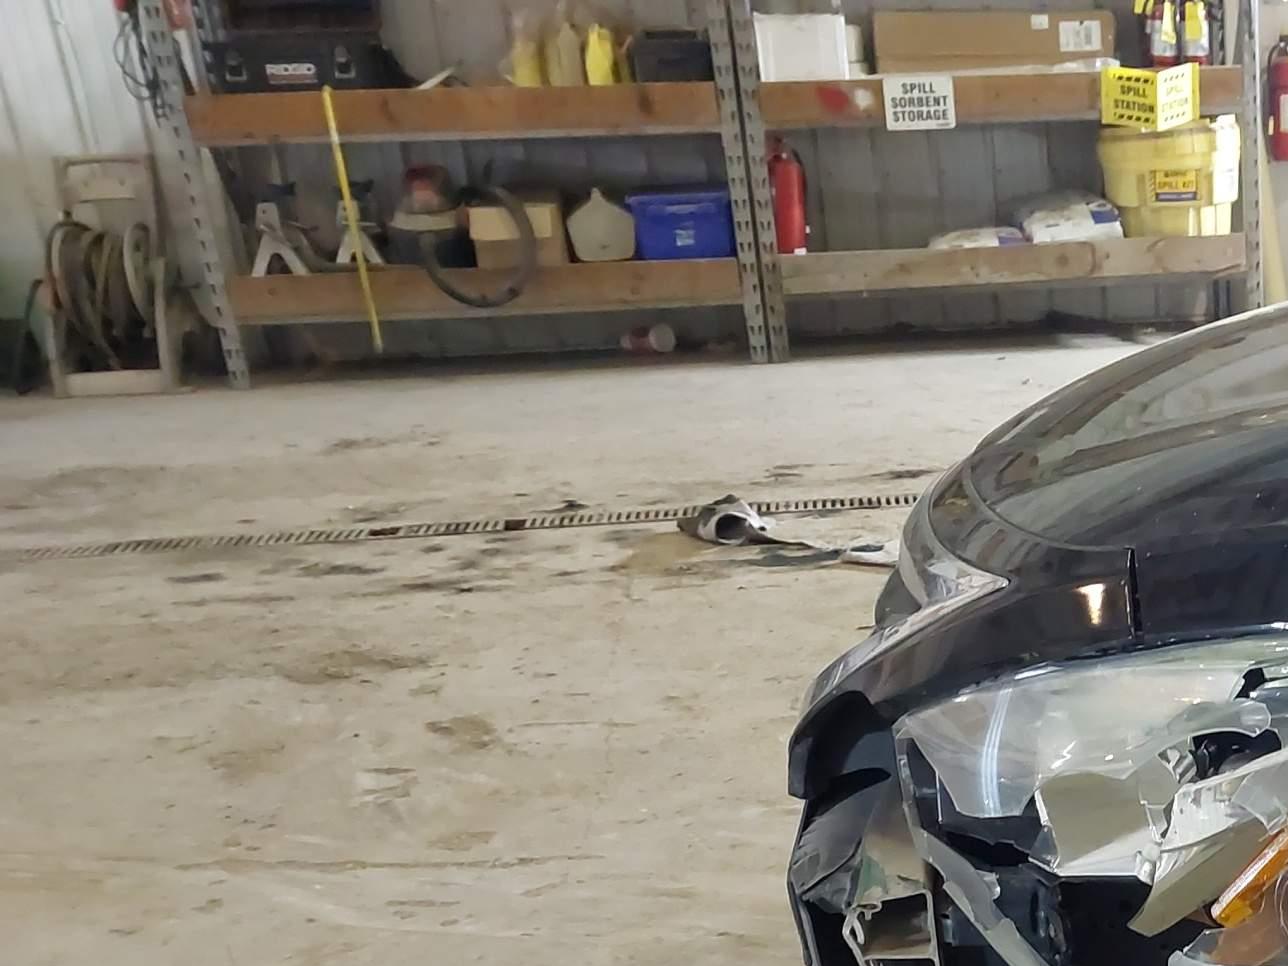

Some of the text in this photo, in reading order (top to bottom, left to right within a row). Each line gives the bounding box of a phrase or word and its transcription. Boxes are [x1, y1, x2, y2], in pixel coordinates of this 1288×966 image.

[900, 82, 936, 94] SPILL
[1120, 84, 1147, 98] SPILL
[890, 95, 948, 109] SORBENT
[1113, 98, 1154, 113] STATION
[892, 109, 949, 123] STORAGE
